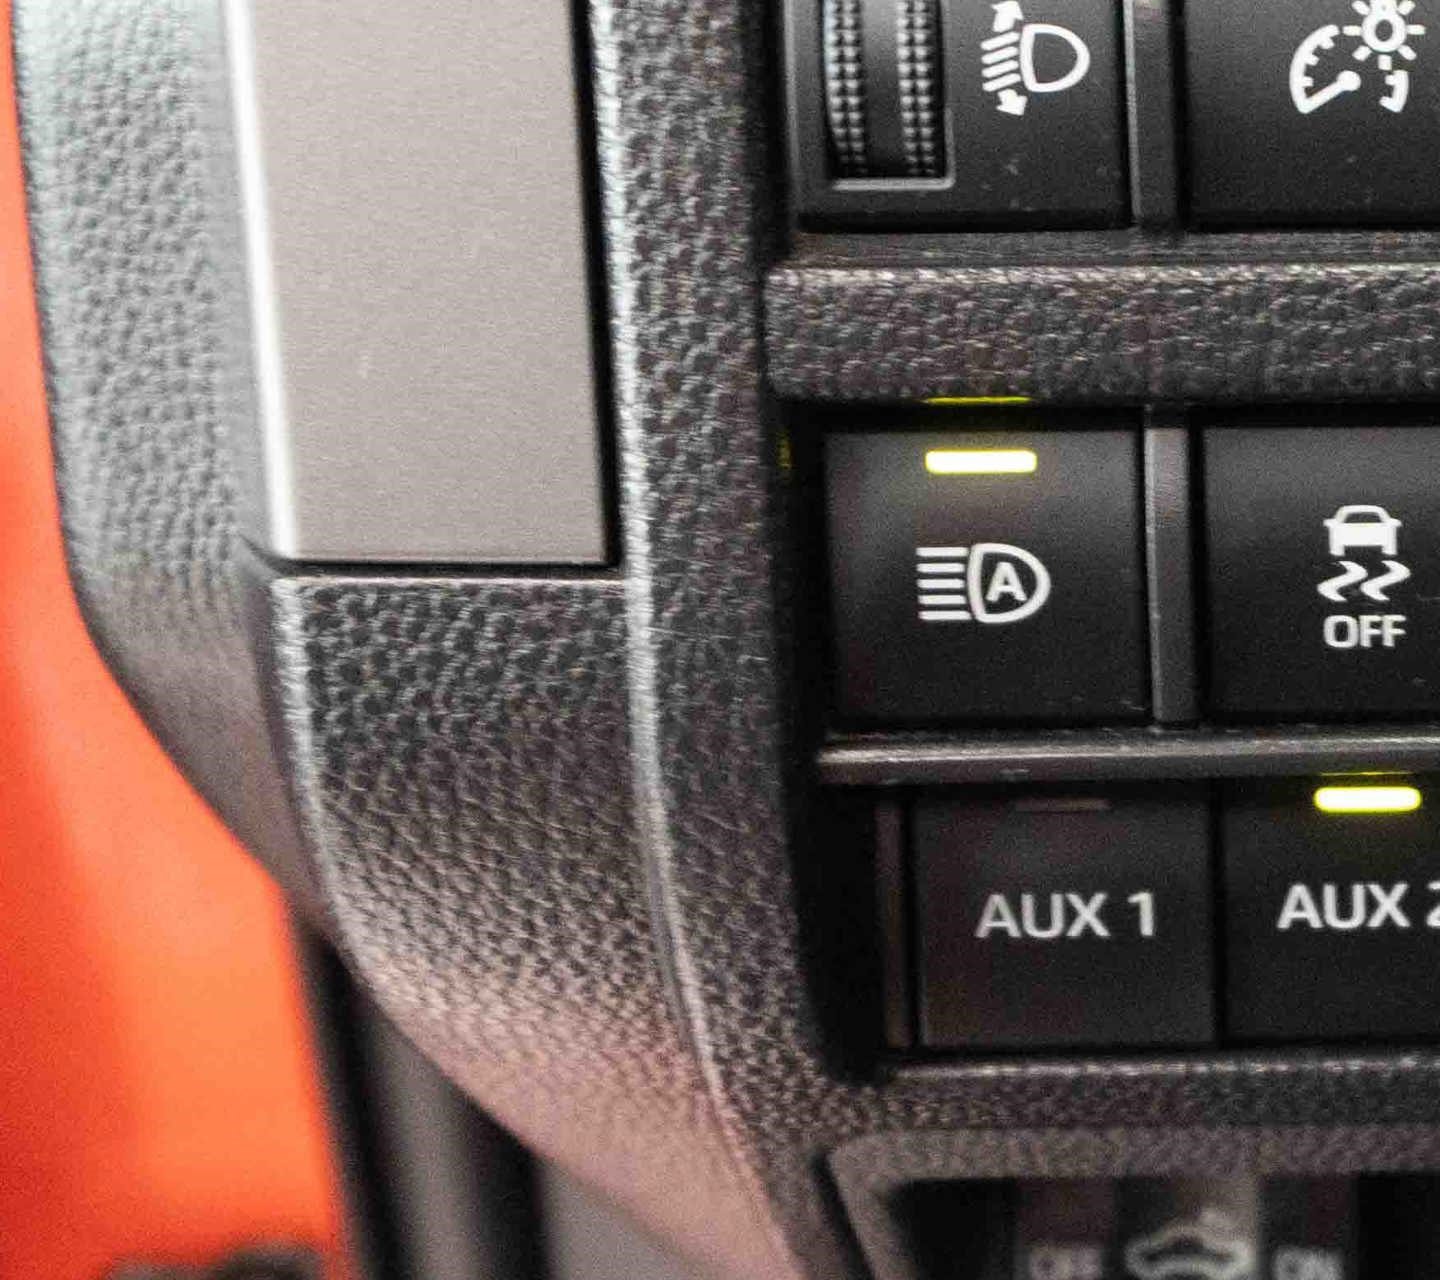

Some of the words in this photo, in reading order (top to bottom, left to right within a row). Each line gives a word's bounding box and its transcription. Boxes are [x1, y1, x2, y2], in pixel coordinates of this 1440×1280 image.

[1323, 614, 1407, 649] OFF
[975, 892, 1109, 939] AUX
[1128, 892, 1155, 936] 1
[1276, 882, 1409, 929] AUX
